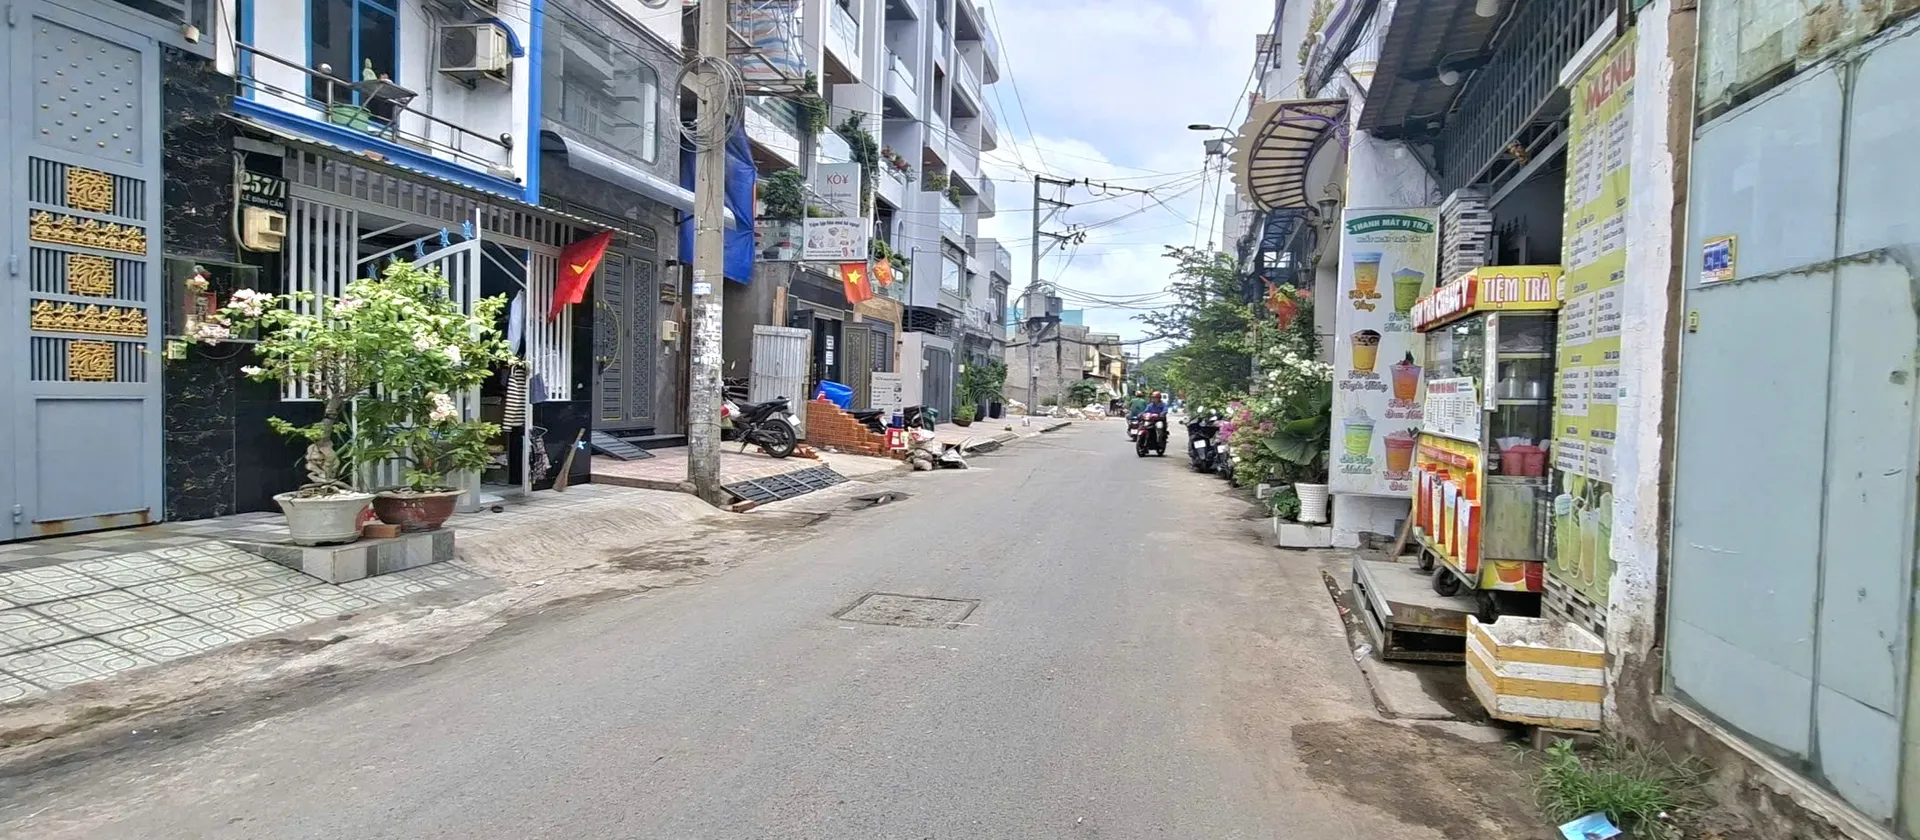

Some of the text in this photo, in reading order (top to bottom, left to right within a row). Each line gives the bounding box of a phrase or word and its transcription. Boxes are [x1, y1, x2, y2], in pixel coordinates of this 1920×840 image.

[1585, 43, 1636, 115] MENU
[240, 171, 287, 199] 257/1
[1352, 219, 1380, 231] THANH
[1483, 273, 1519, 308] TIỆM
[1523, 272, 1550, 303] TRÀ
